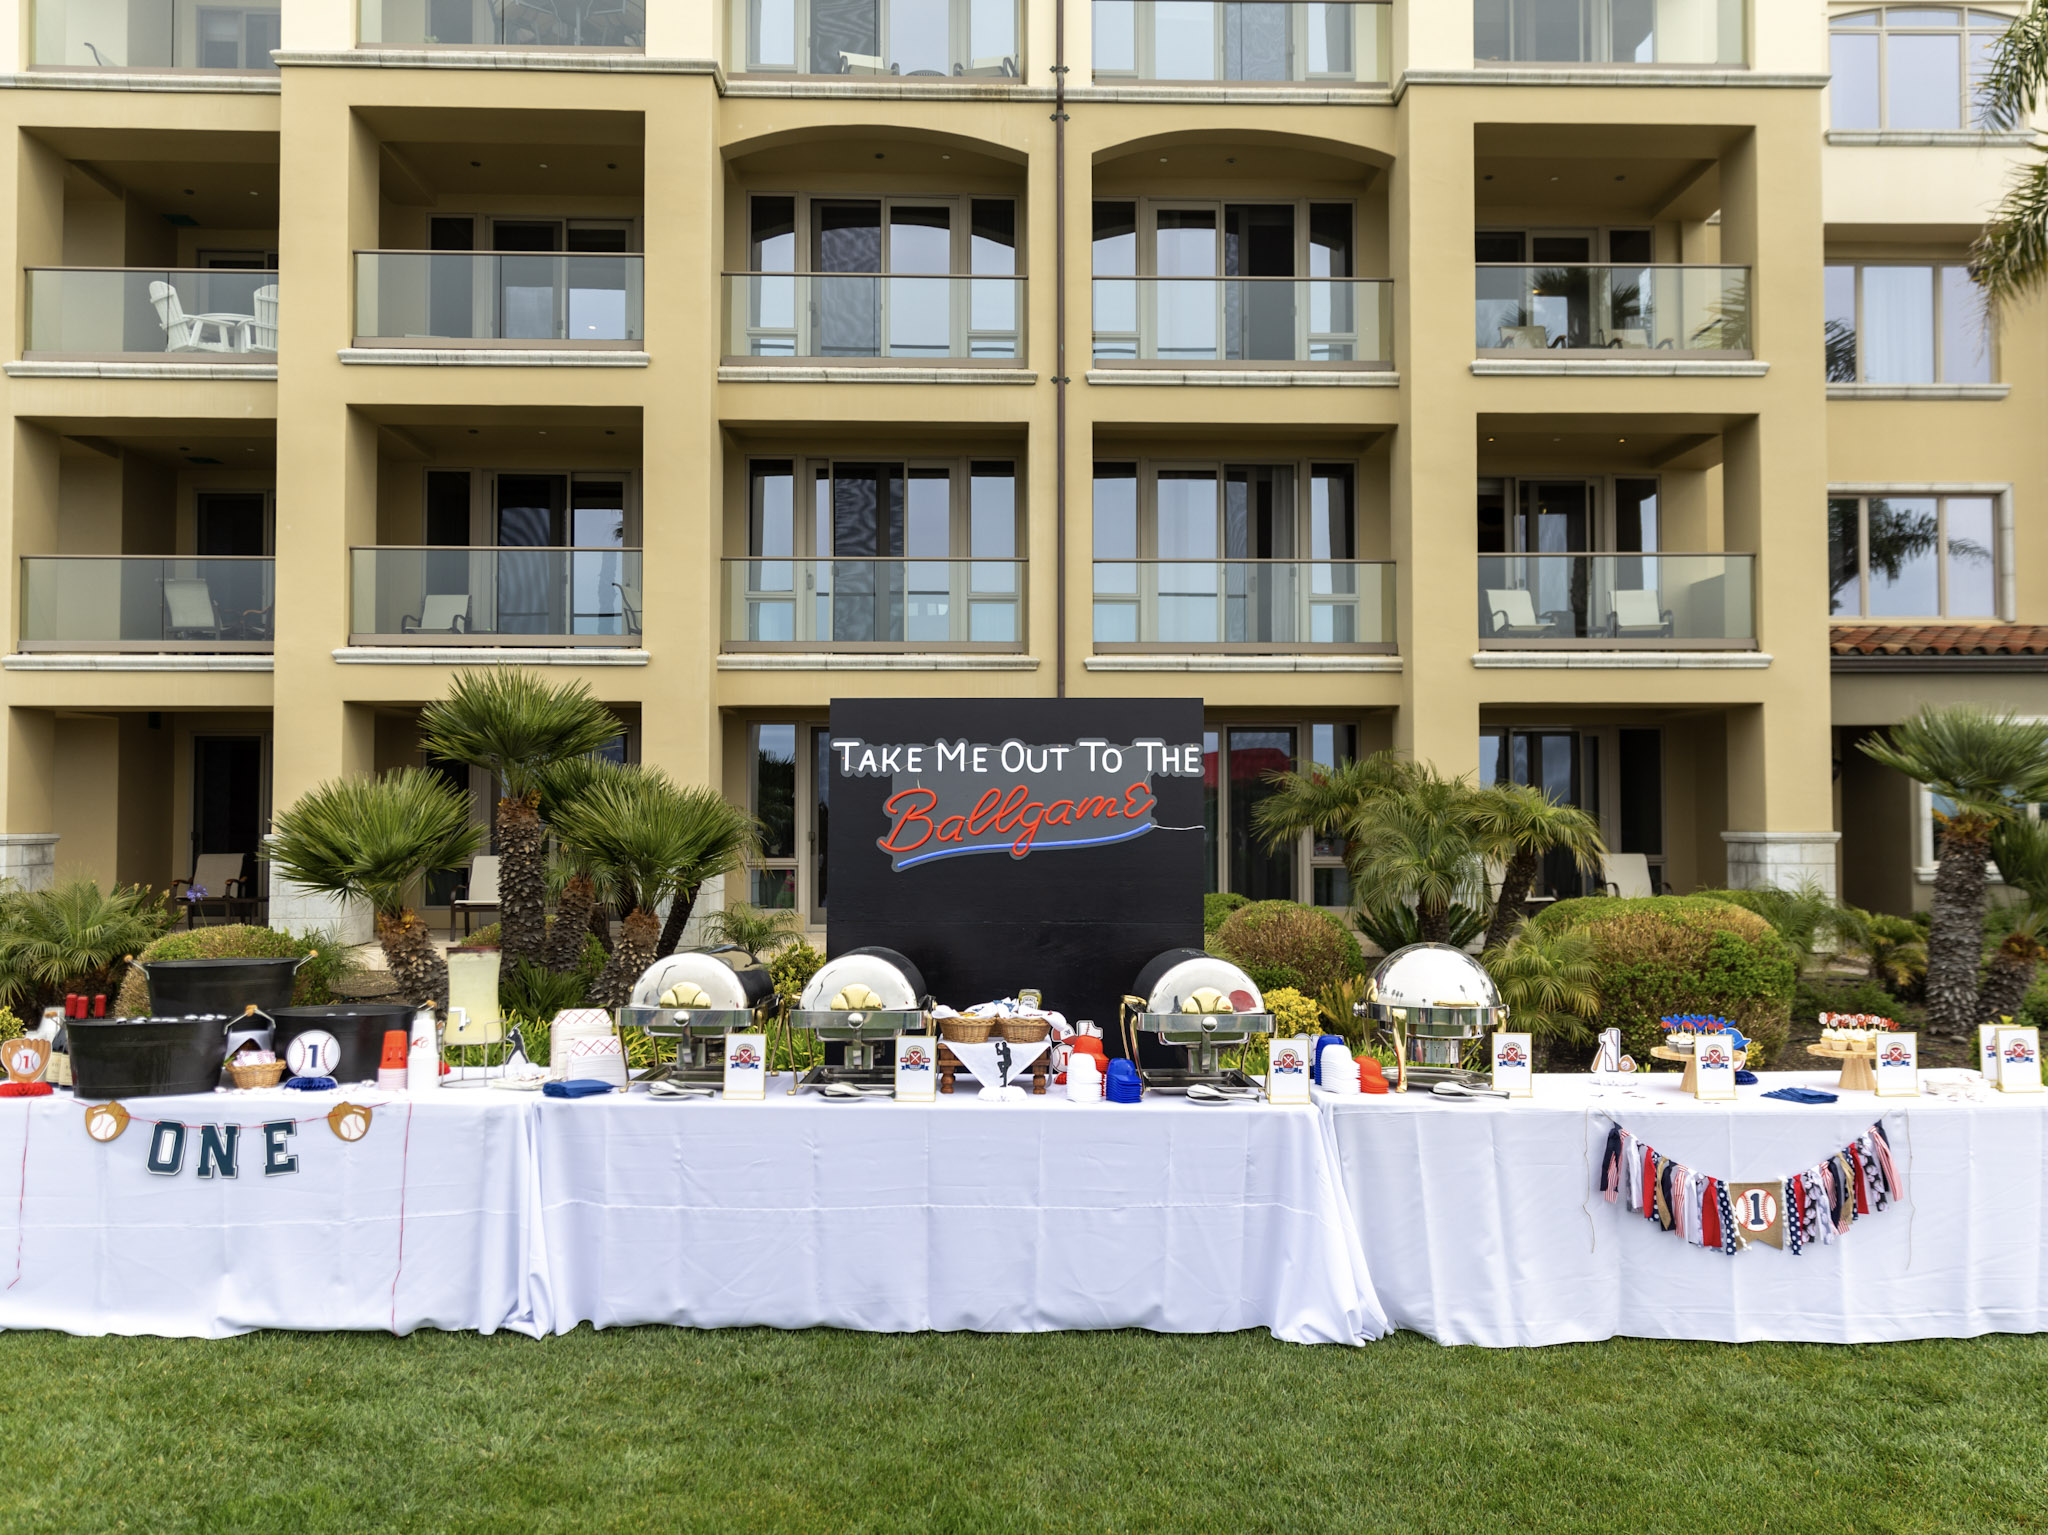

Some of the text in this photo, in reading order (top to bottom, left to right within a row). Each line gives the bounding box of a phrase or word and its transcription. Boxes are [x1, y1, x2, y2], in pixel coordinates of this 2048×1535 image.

[23, 1055, 29, 1069] 1
[308, 1044, 318, 1068] 1
[1062, 1052, 1068, 1066] 1
[146, 1118, 299, 1179] ONE
[1750, 1192, 1765, 1226] 1
